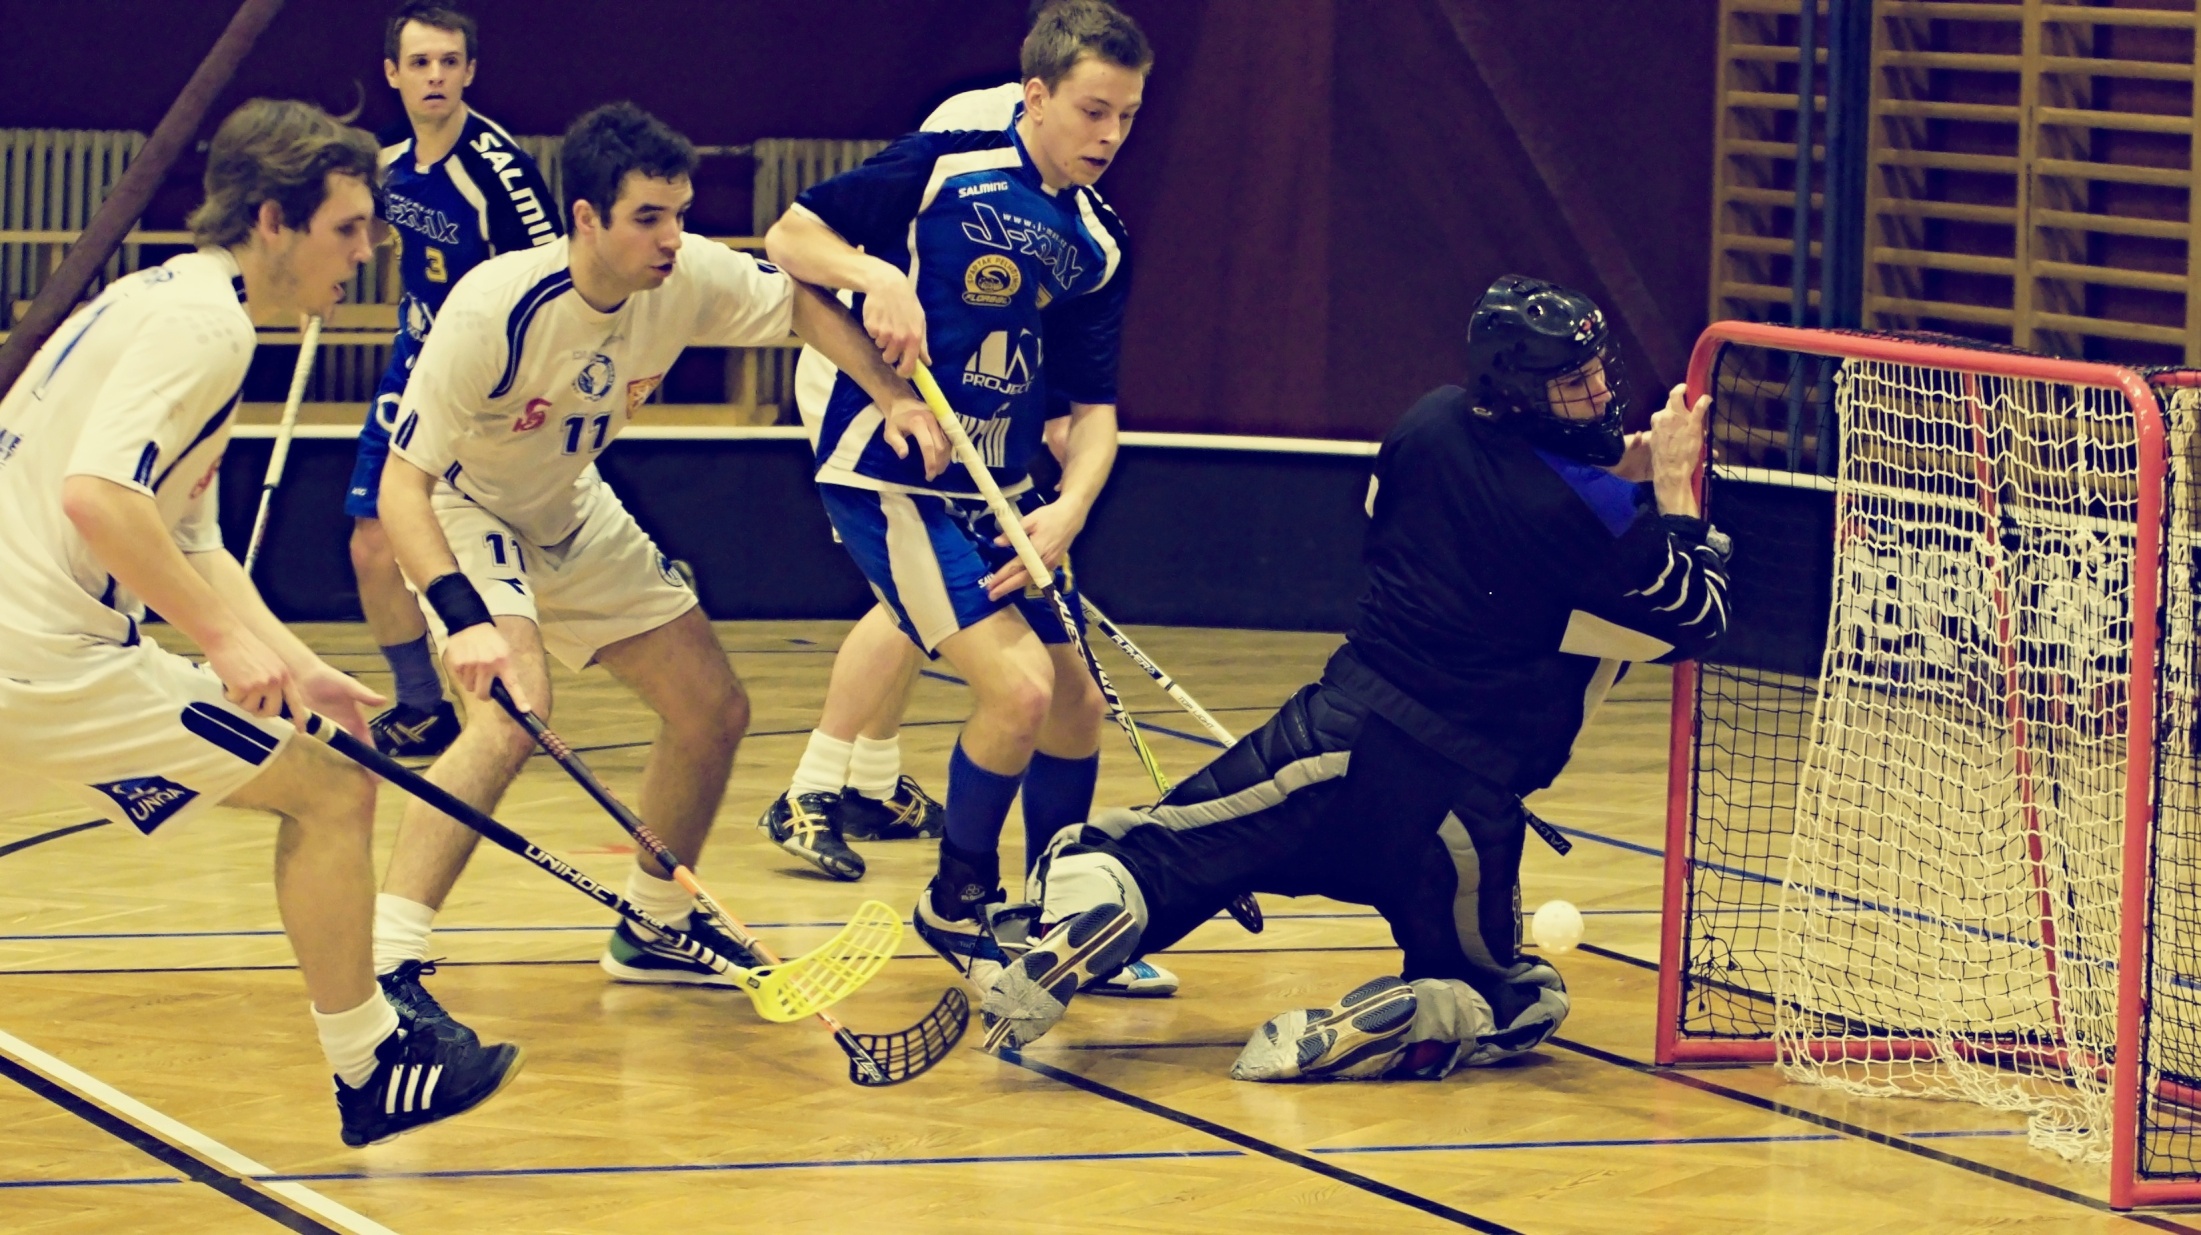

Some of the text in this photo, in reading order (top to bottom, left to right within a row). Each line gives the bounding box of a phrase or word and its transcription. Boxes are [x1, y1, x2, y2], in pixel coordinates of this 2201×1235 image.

[469, 132, 558, 247] SALMI
[958, 181, 1009, 198] SALMING
[425, 246, 448, 283] 3
[962, 371, 1035, 395] PROJECT
[561, 411, 613, 456] 11
[483, 531, 527, 575] 11
[1177, 695, 1215, 730] TOP LIGHT
[524, 844, 614, 902] UNIHOC
